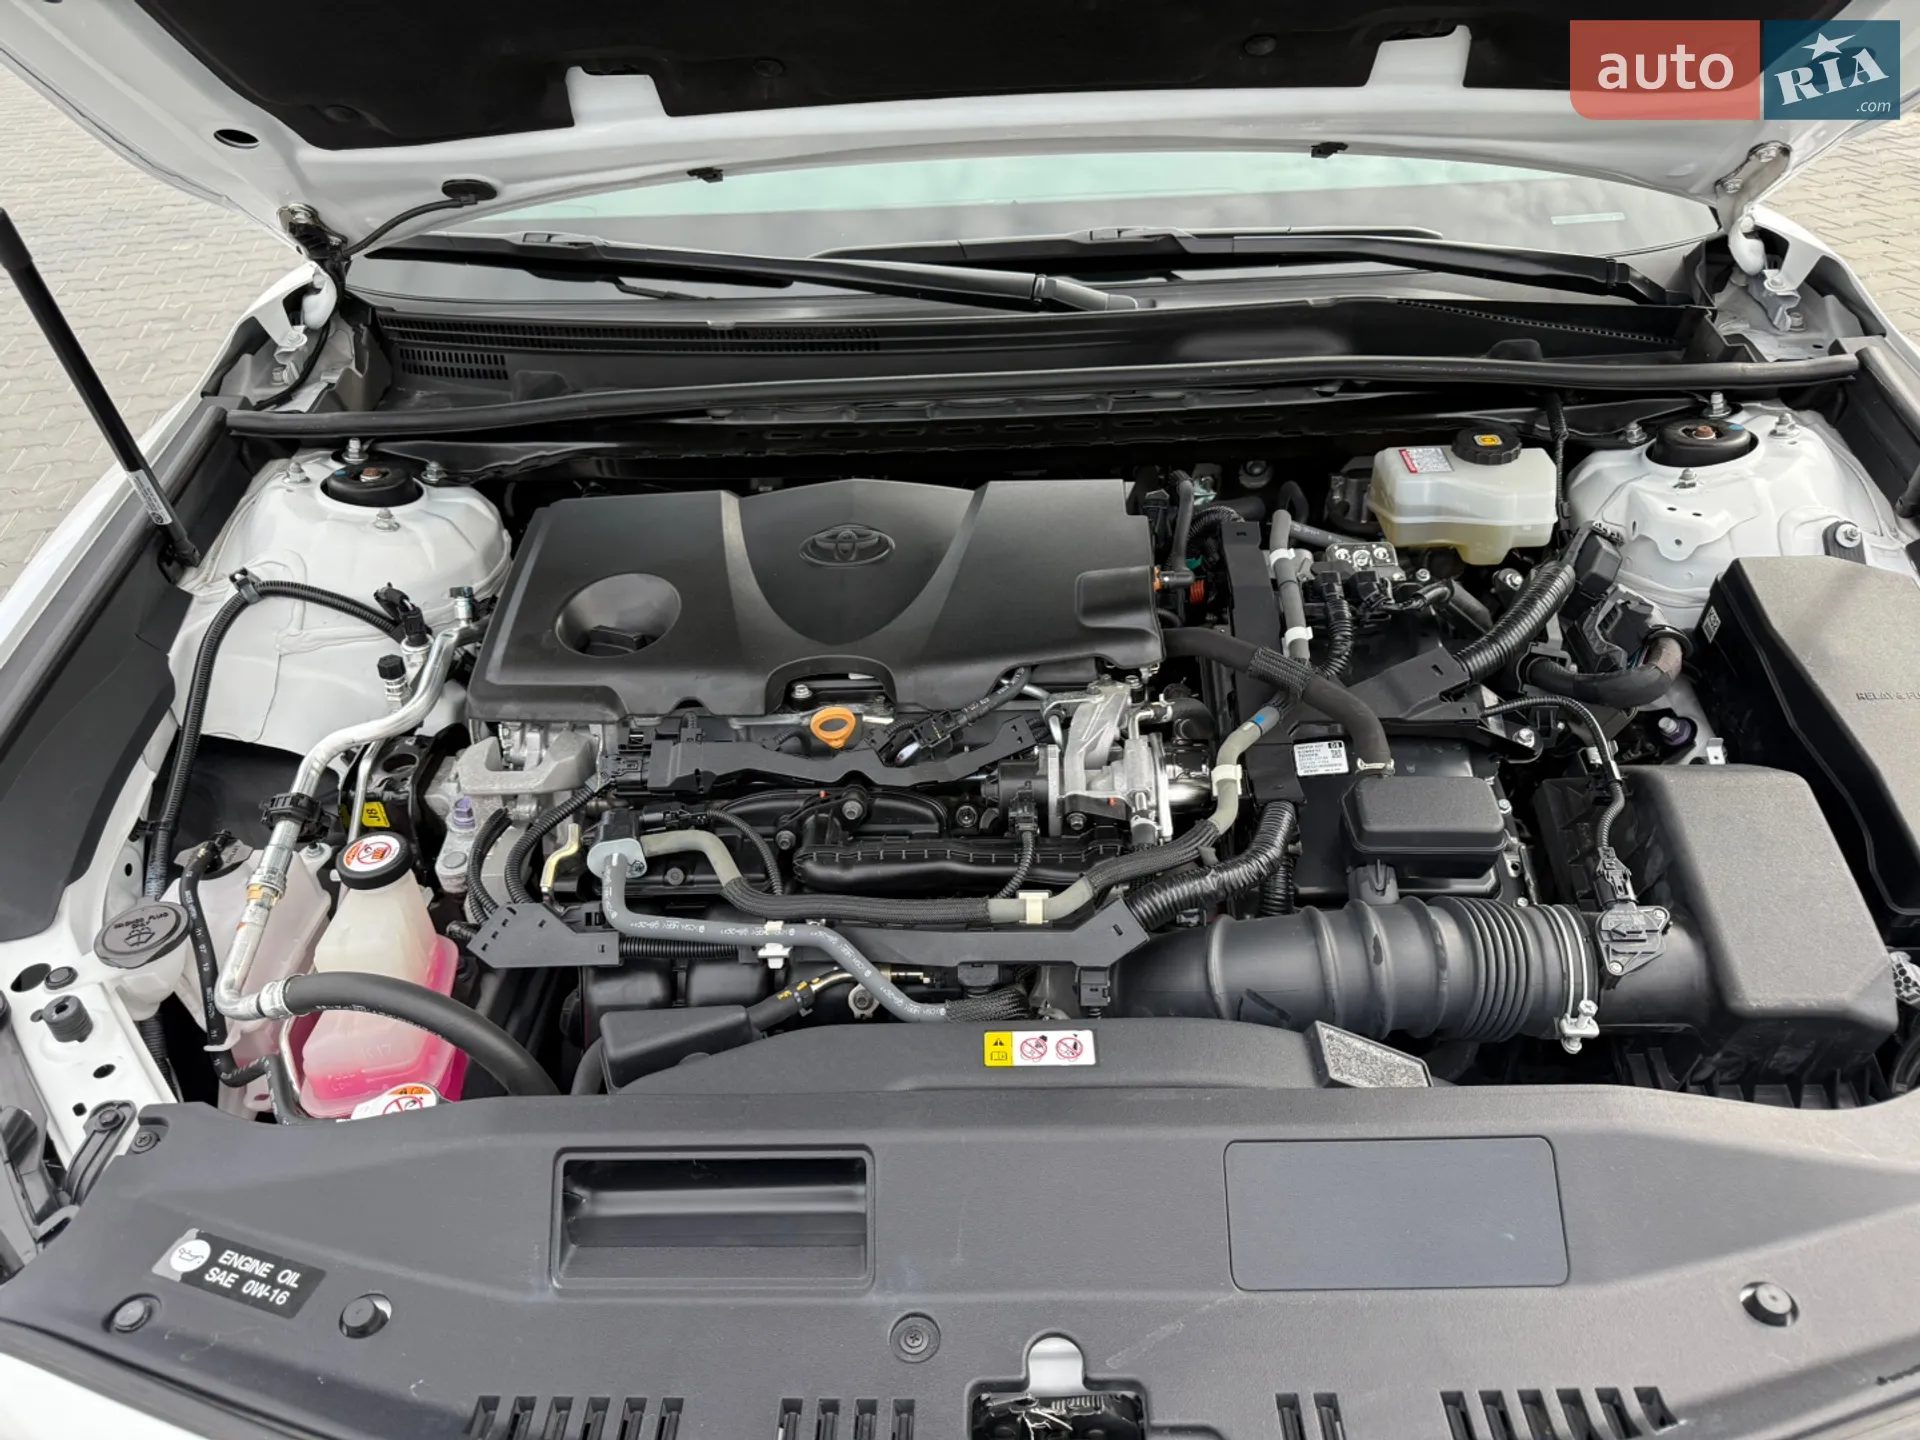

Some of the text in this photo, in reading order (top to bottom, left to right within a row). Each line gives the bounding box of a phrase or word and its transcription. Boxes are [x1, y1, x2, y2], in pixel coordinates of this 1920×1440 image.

[1855, 691, 1893, 700] RELAY
[204, 1267, 291, 1306] SAE 0W-16
[217, 1249, 302, 1288] ENGINE OIL
